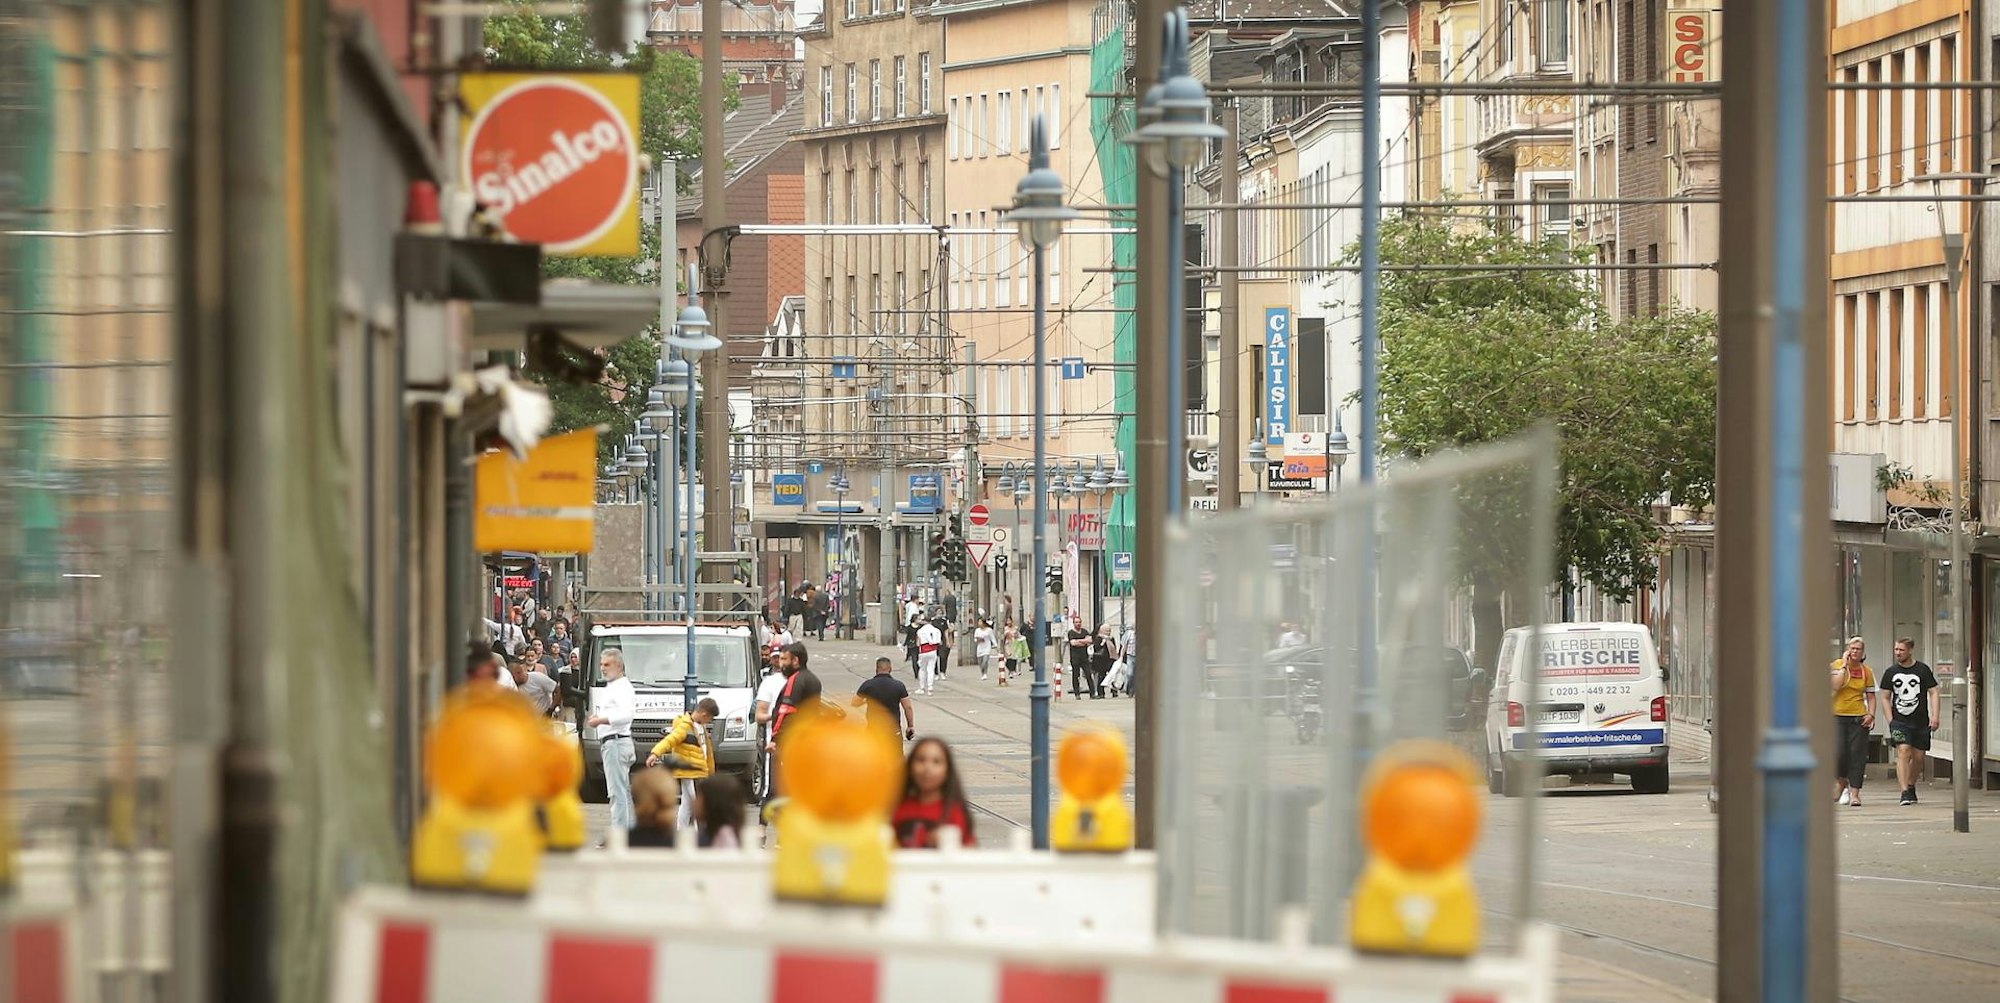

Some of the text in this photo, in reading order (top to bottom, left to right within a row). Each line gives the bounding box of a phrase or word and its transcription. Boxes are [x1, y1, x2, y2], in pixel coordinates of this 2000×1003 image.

[477, 120, 618, 221] Sinalco
[1556, 687, 1579, 696] 0203
[1587, 686, 1604, 695] 449
[1606, 686, 1618, 695] 22
[1620, 685, 1631, 694] 32
[1559, 711, 1578, 720] 1038
